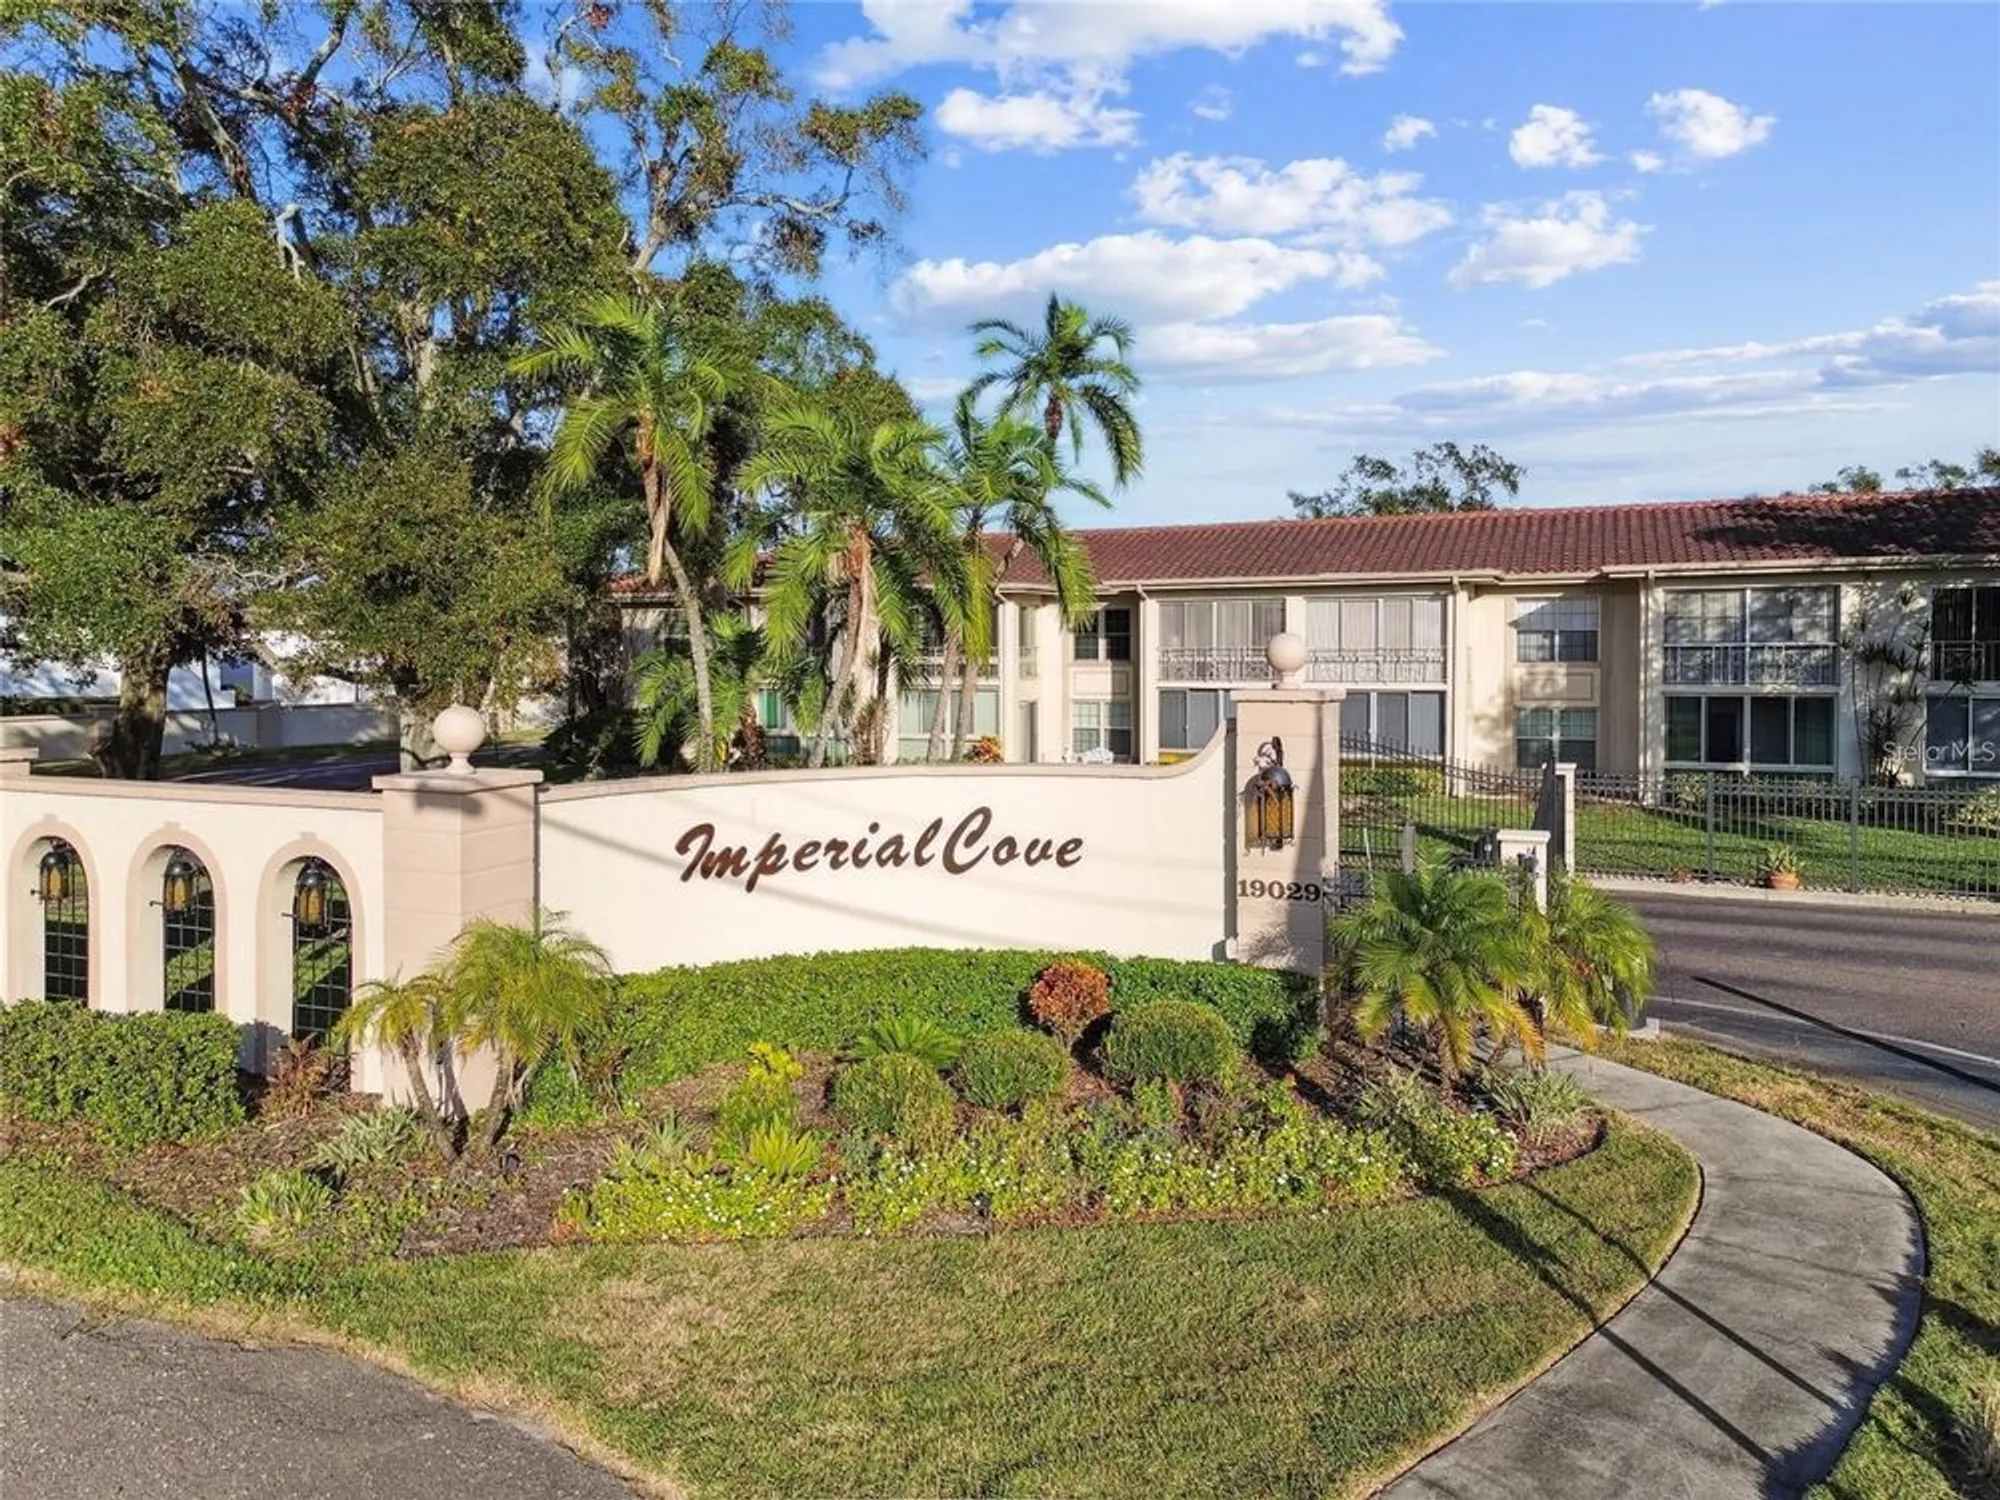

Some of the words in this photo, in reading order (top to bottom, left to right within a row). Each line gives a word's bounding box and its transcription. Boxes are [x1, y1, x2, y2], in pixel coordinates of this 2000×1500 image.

[674, 816, 944, 894] Imperial
[941, 806, 1084, 875] Cove
[1238, 879, 1321, 902] 19029
